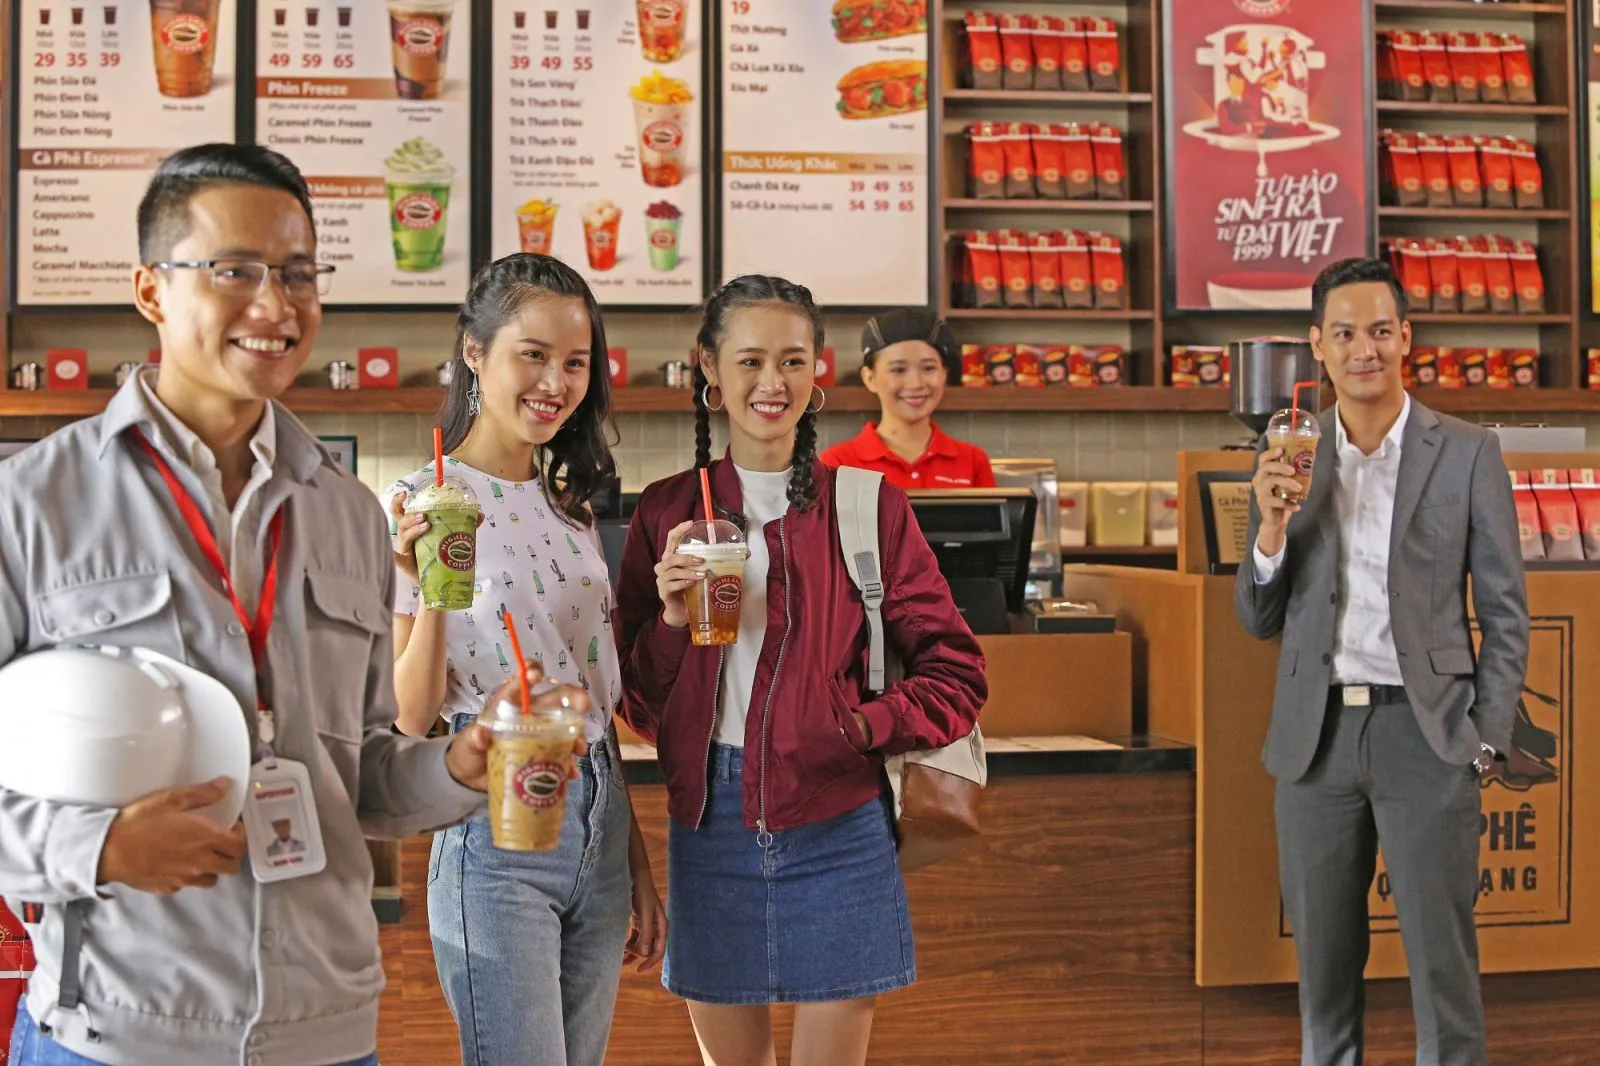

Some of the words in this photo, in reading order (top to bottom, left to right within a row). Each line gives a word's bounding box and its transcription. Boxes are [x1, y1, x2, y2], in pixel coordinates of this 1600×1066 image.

[732, 1, 750, 14] 19
[34, 52, 55, 68] 29
[67, 52, 88, 67] 35
[99, 52, 120, 67] 39
[269, 53, 290, 68] 49
[302, 53, 322, 68] 59
[333, 54, 354, 69] 65
[510, 55, 530, 70] 39
[541, 56, 562, 70] 49
[573, 56, 593, 71] 55
[34, 75, 57, 85] Phin
[81, 75, 97, 85] Đá
[528, 79, 546, 88] Sen
[268, 81, 299, 95] Phin
[302, 83, 348, 96] Freeze
[34, 92, 57, 102] Phin
[34, 109, 57, 119] Phin
[82, 110, 111, 121] Nóng
[268, 117, 310, 127] Caramel
[313, 118, 336, 127] Phin
[339, 118, 373, 128] Freeze
[34, 126, 57, 136] Phin
[83, 127, 113, 138] Nóng
[268, 134, 300, 144] Classic
[304, 135, 328, 144] Phin
[330, 135, 364, 145] Freeze
[32, 151, 51, 165] Cà
[55, 151, 81, 165] Phê
[528, 156, 553, 165] Xanh
[33, 176, 80, 187] Espresso
[730, 181, 762, 190] Chanh
[782, 181, 800, 192] Xay
[849, 180, 865, 192] 39
[873, 180, 889, 192] 49
[899, 181, 914, 193] 55
[33, 193, 90, 202] Americano
[849, 199, 865, 212] 54
[873, 199, 890, 212] 59
[898, 200, 915, 213] 65
[1214, 197, 1285, 224] SINH
[1285, 194, 1325, 220] RA
[33, 211, 94, 221] Cappuccino
[322, 217, 348, 226] Xanh
[33, 227, 60, 236] Latte
[320, 233, 350, 244] Cô-La
[33, 245, 68, 253] Mocha
[1233, 243, 1273, 261] 1999
[320, 251, 354, 260] Cream
[33, 261, 76, 270] Caramel
[1479, 866, 1537, 896] ẠNG
